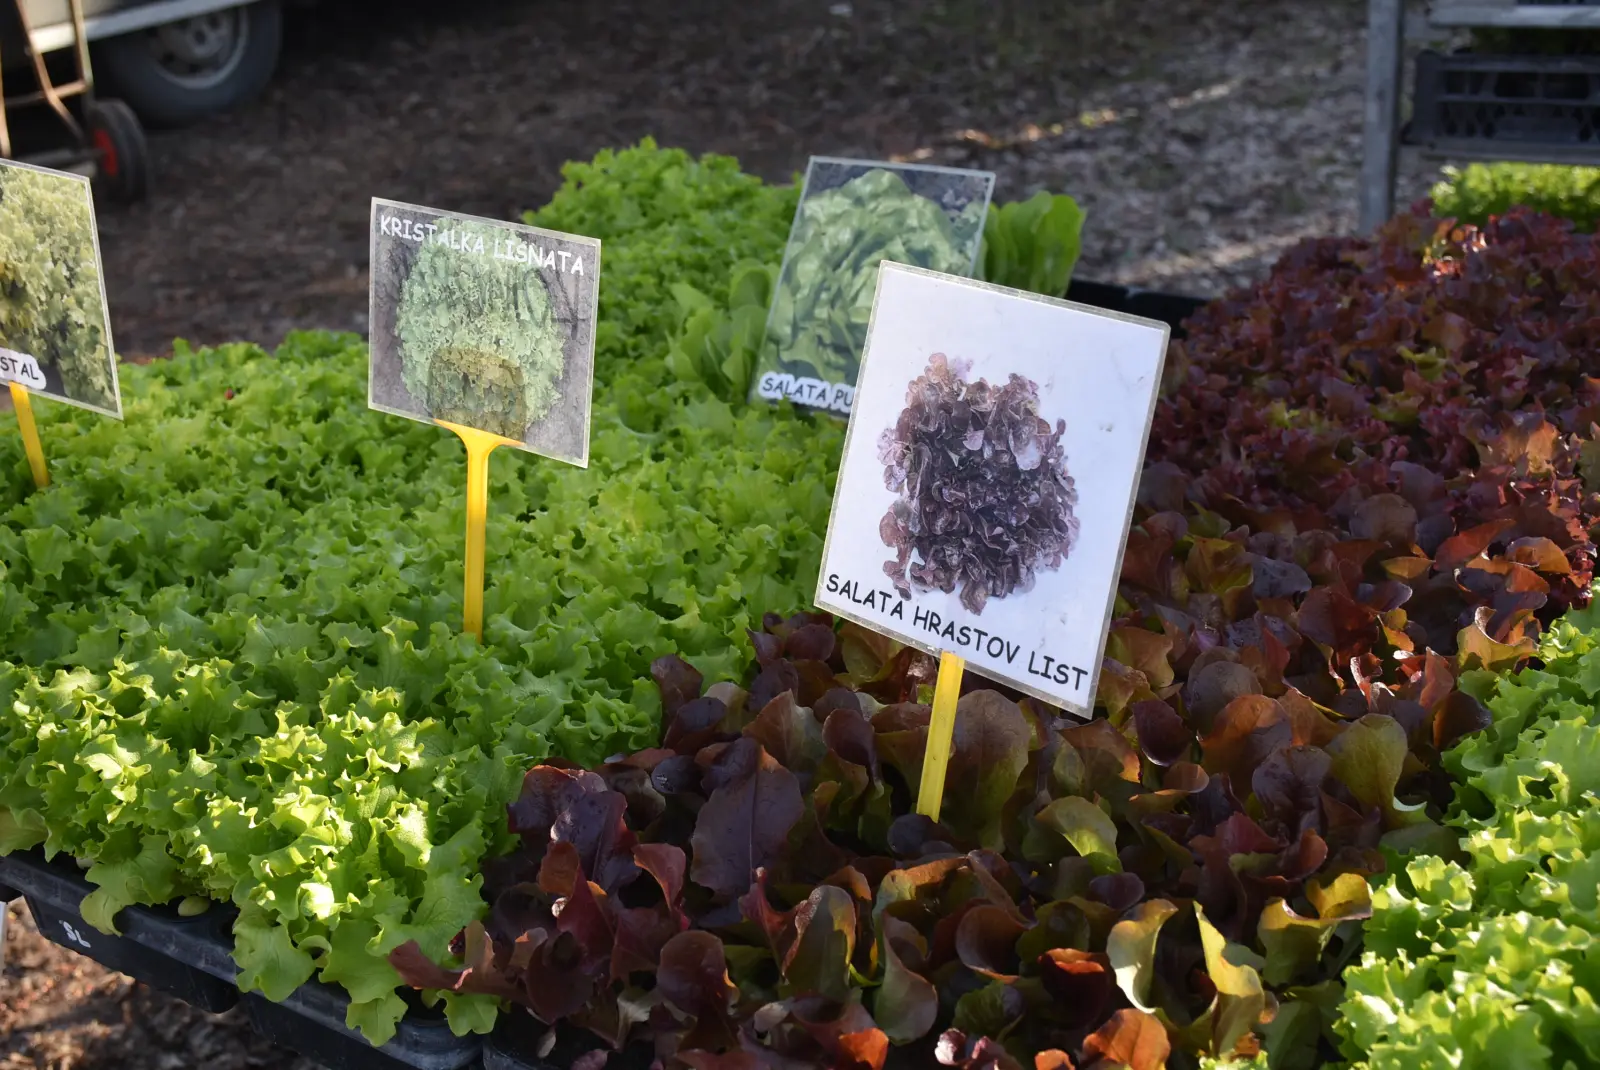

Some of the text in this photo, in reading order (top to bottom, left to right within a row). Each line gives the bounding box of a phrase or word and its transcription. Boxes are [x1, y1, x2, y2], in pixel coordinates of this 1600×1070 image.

[380, 215, 584, 276] KRISTALKA LISNATA
[762, 377, 826, 401] SALATA
[826, 573, 1088, 690] SALATA HRASTOV LIST
